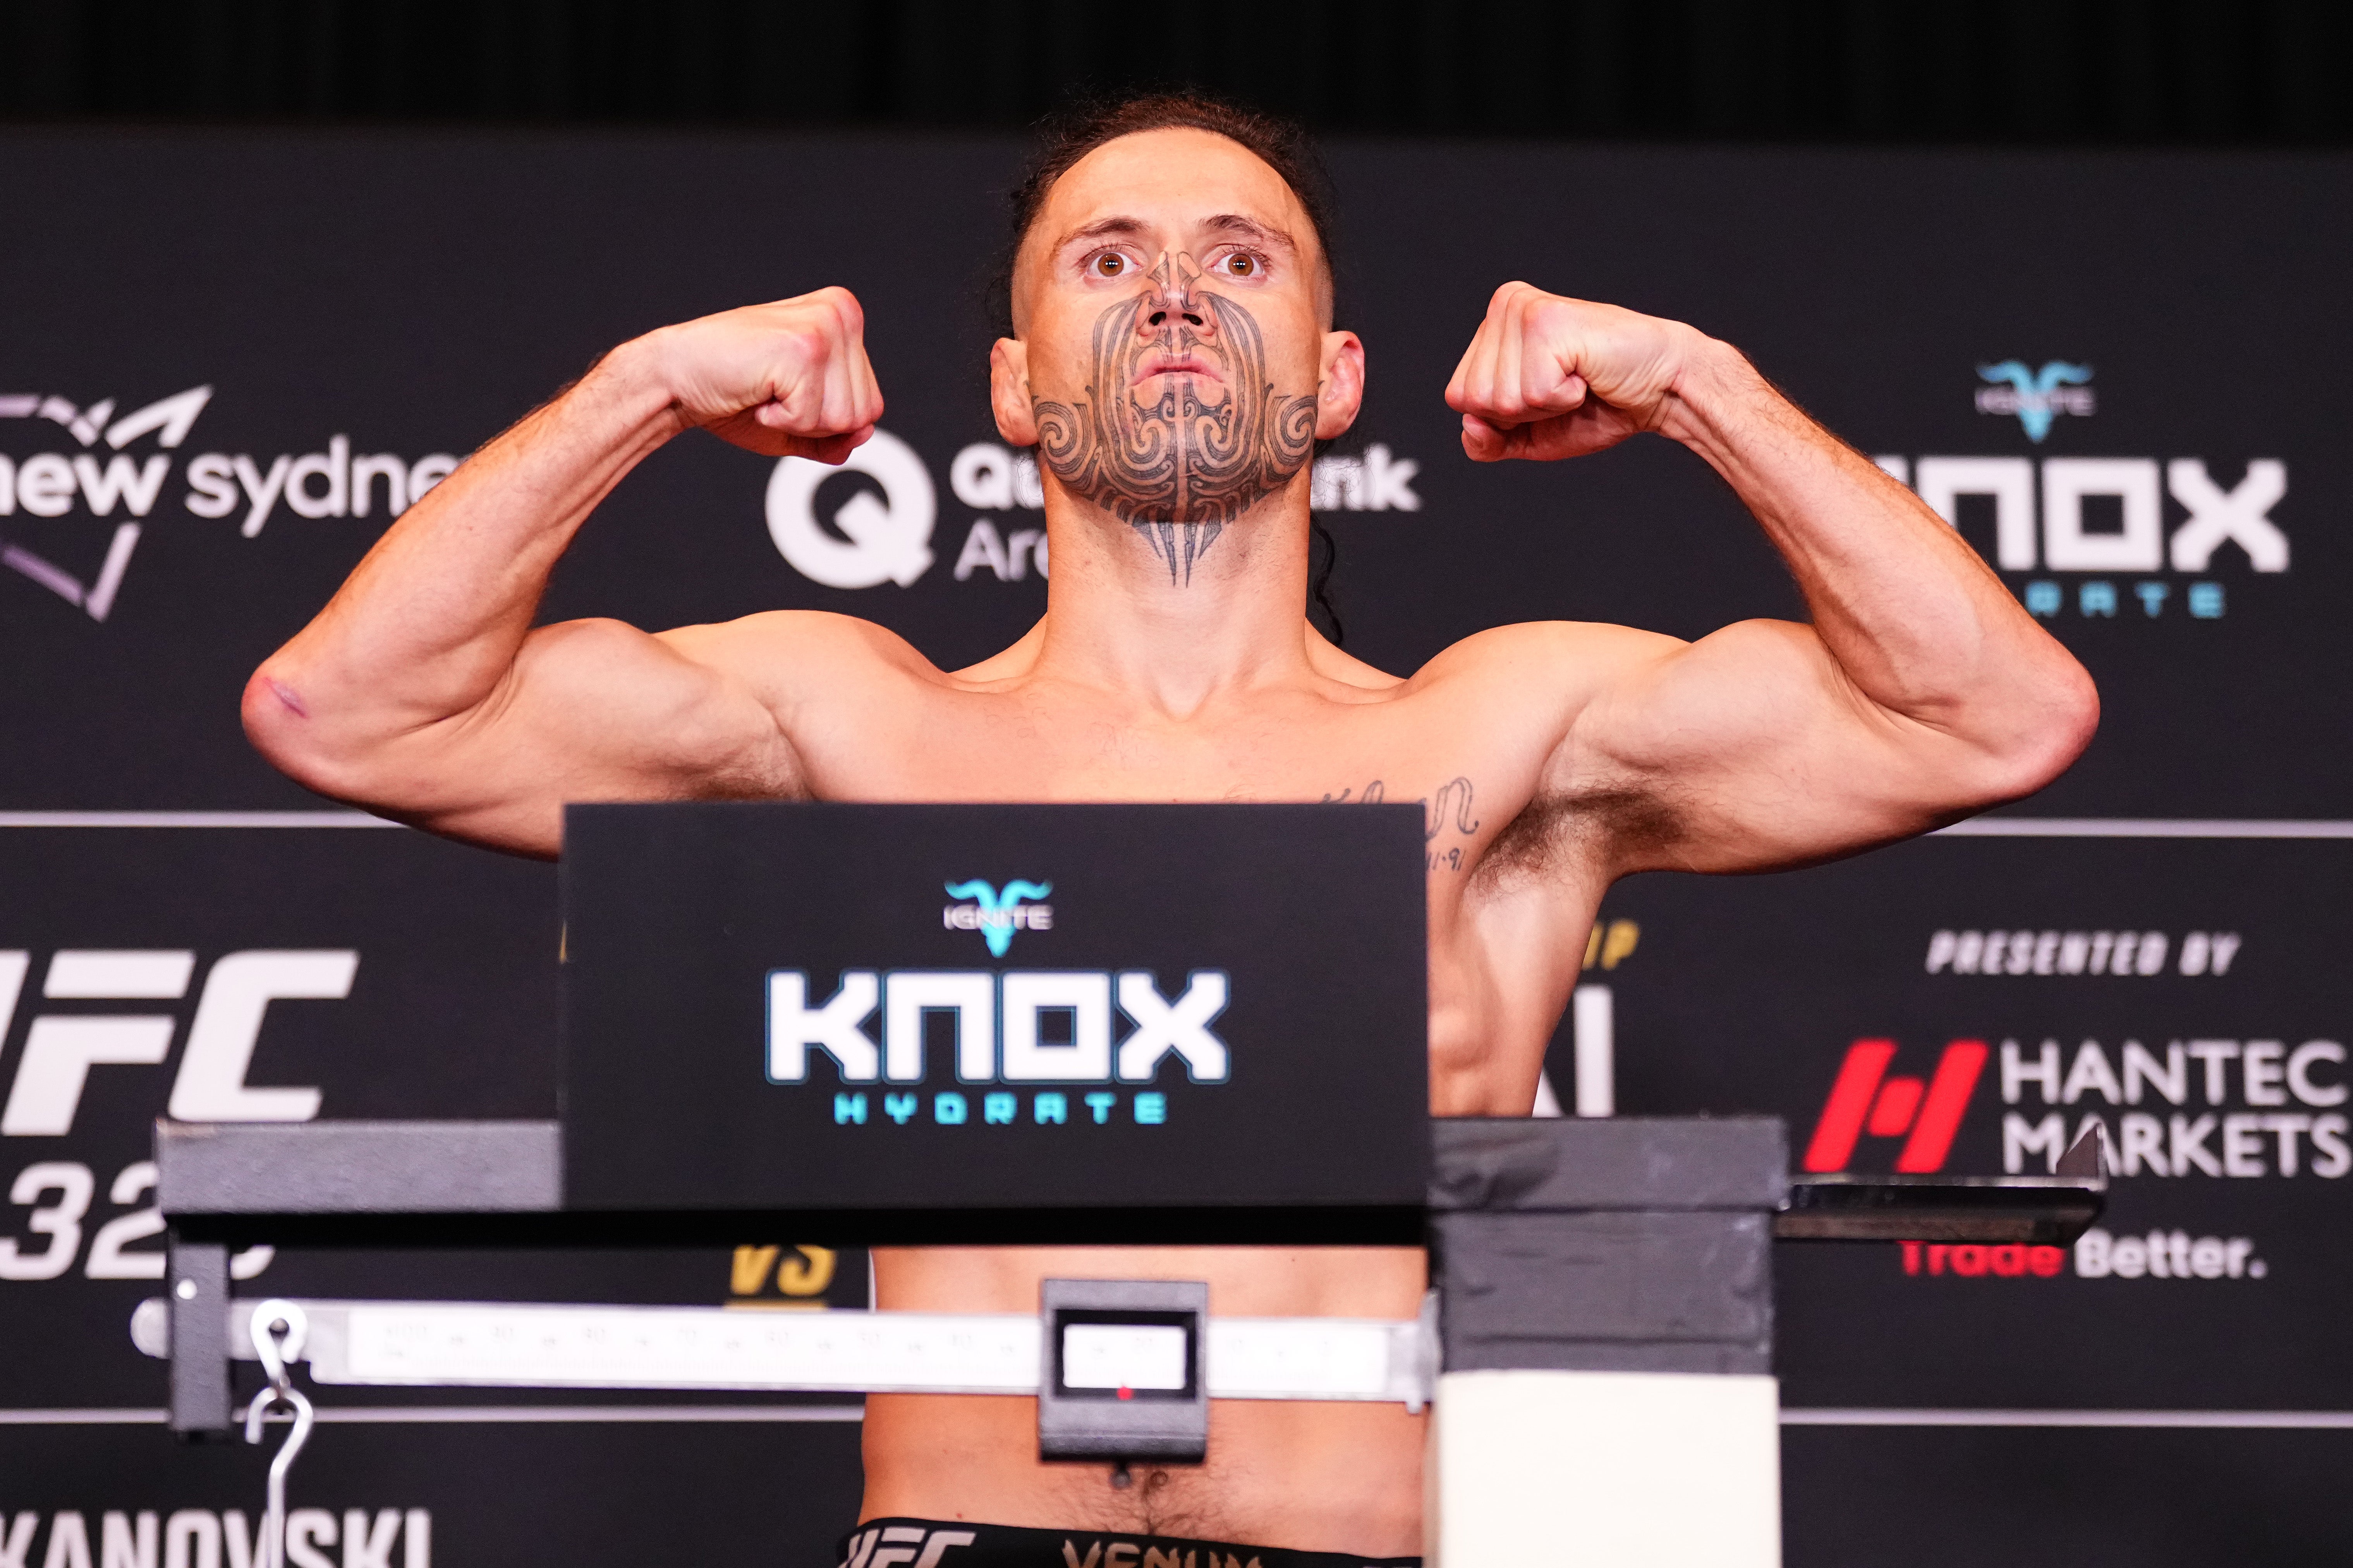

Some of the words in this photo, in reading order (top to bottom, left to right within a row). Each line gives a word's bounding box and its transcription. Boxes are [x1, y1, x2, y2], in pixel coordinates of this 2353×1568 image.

[1874, 457, 2289, 572] NOX
[2025, 582, 2224, 618] RATE
[1926, 931, 2168, 975] PRESENTED
[2179, 933, 2240, 976] BY
[765, 969, 1230, 1084] KNOX
[2001, 1040, 2348, 1107] HANTEC
[833, 1092, 1167, 1124] HYDRATE
[0, 1162, 274, 1280] 32
[2075, 1229, 2266, 1278] Better.
